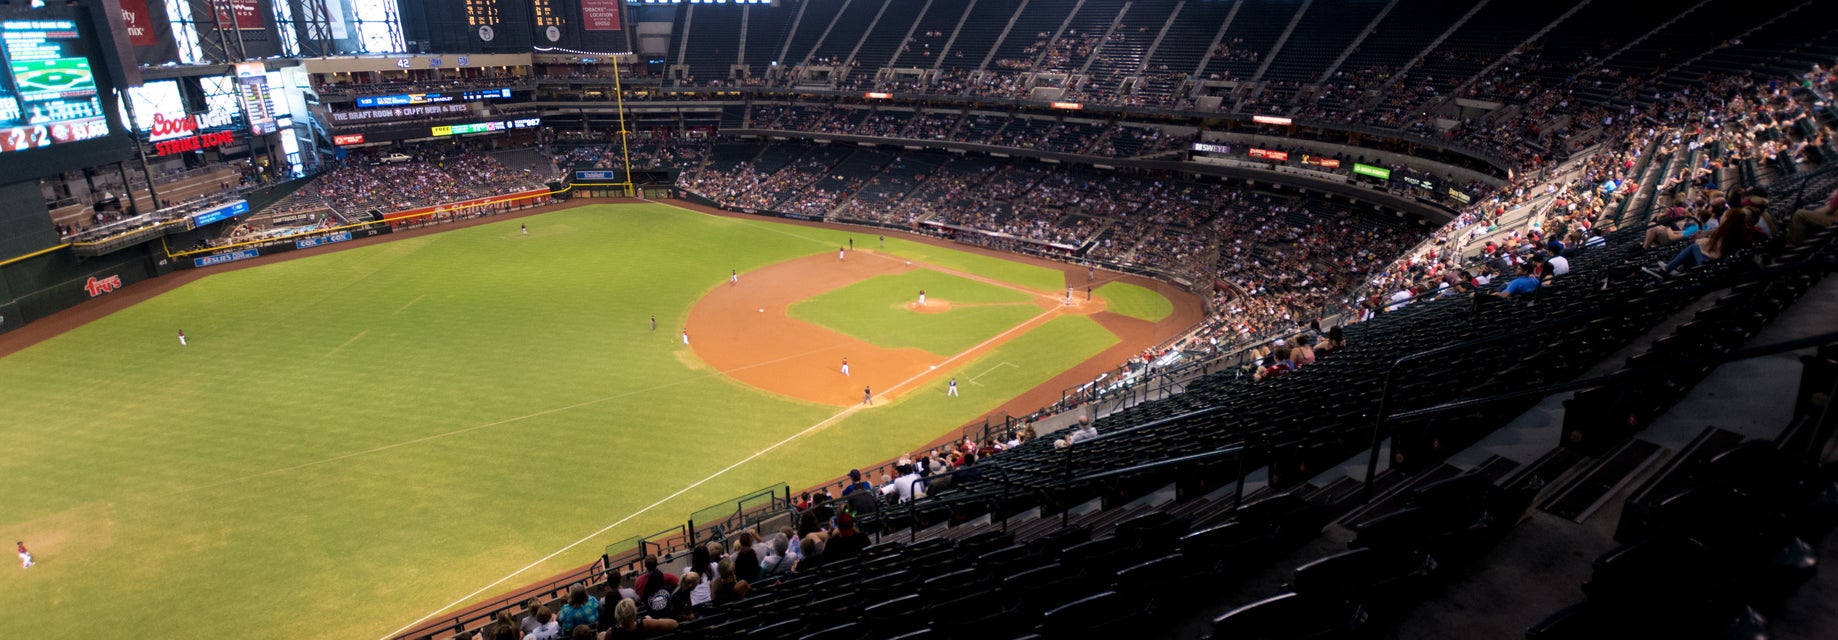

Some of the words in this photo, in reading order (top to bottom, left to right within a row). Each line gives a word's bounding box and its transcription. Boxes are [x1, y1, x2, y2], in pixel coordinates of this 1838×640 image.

[397, 58, 410, 68] 42
[152, 112, 198, 137] Coors
[195, 109, 233, 129] LIGHT
[333, 113, 347, 121] THE
[349, 111, 371, 119] DRAFT
[373, 110, 393, 118] ROOM
[12, 127, 29, 150] 2
[34, 125, 51, 146] 2
[155, 135, 202, 157] STRIKE
[201, 129, 234, 148] ZONE
[484, 198, 512, 212] Farm
[300, 239, 317, 247] COX
[331, 234, 347, 242] COX
[84, 275, 122, 298] fry's
